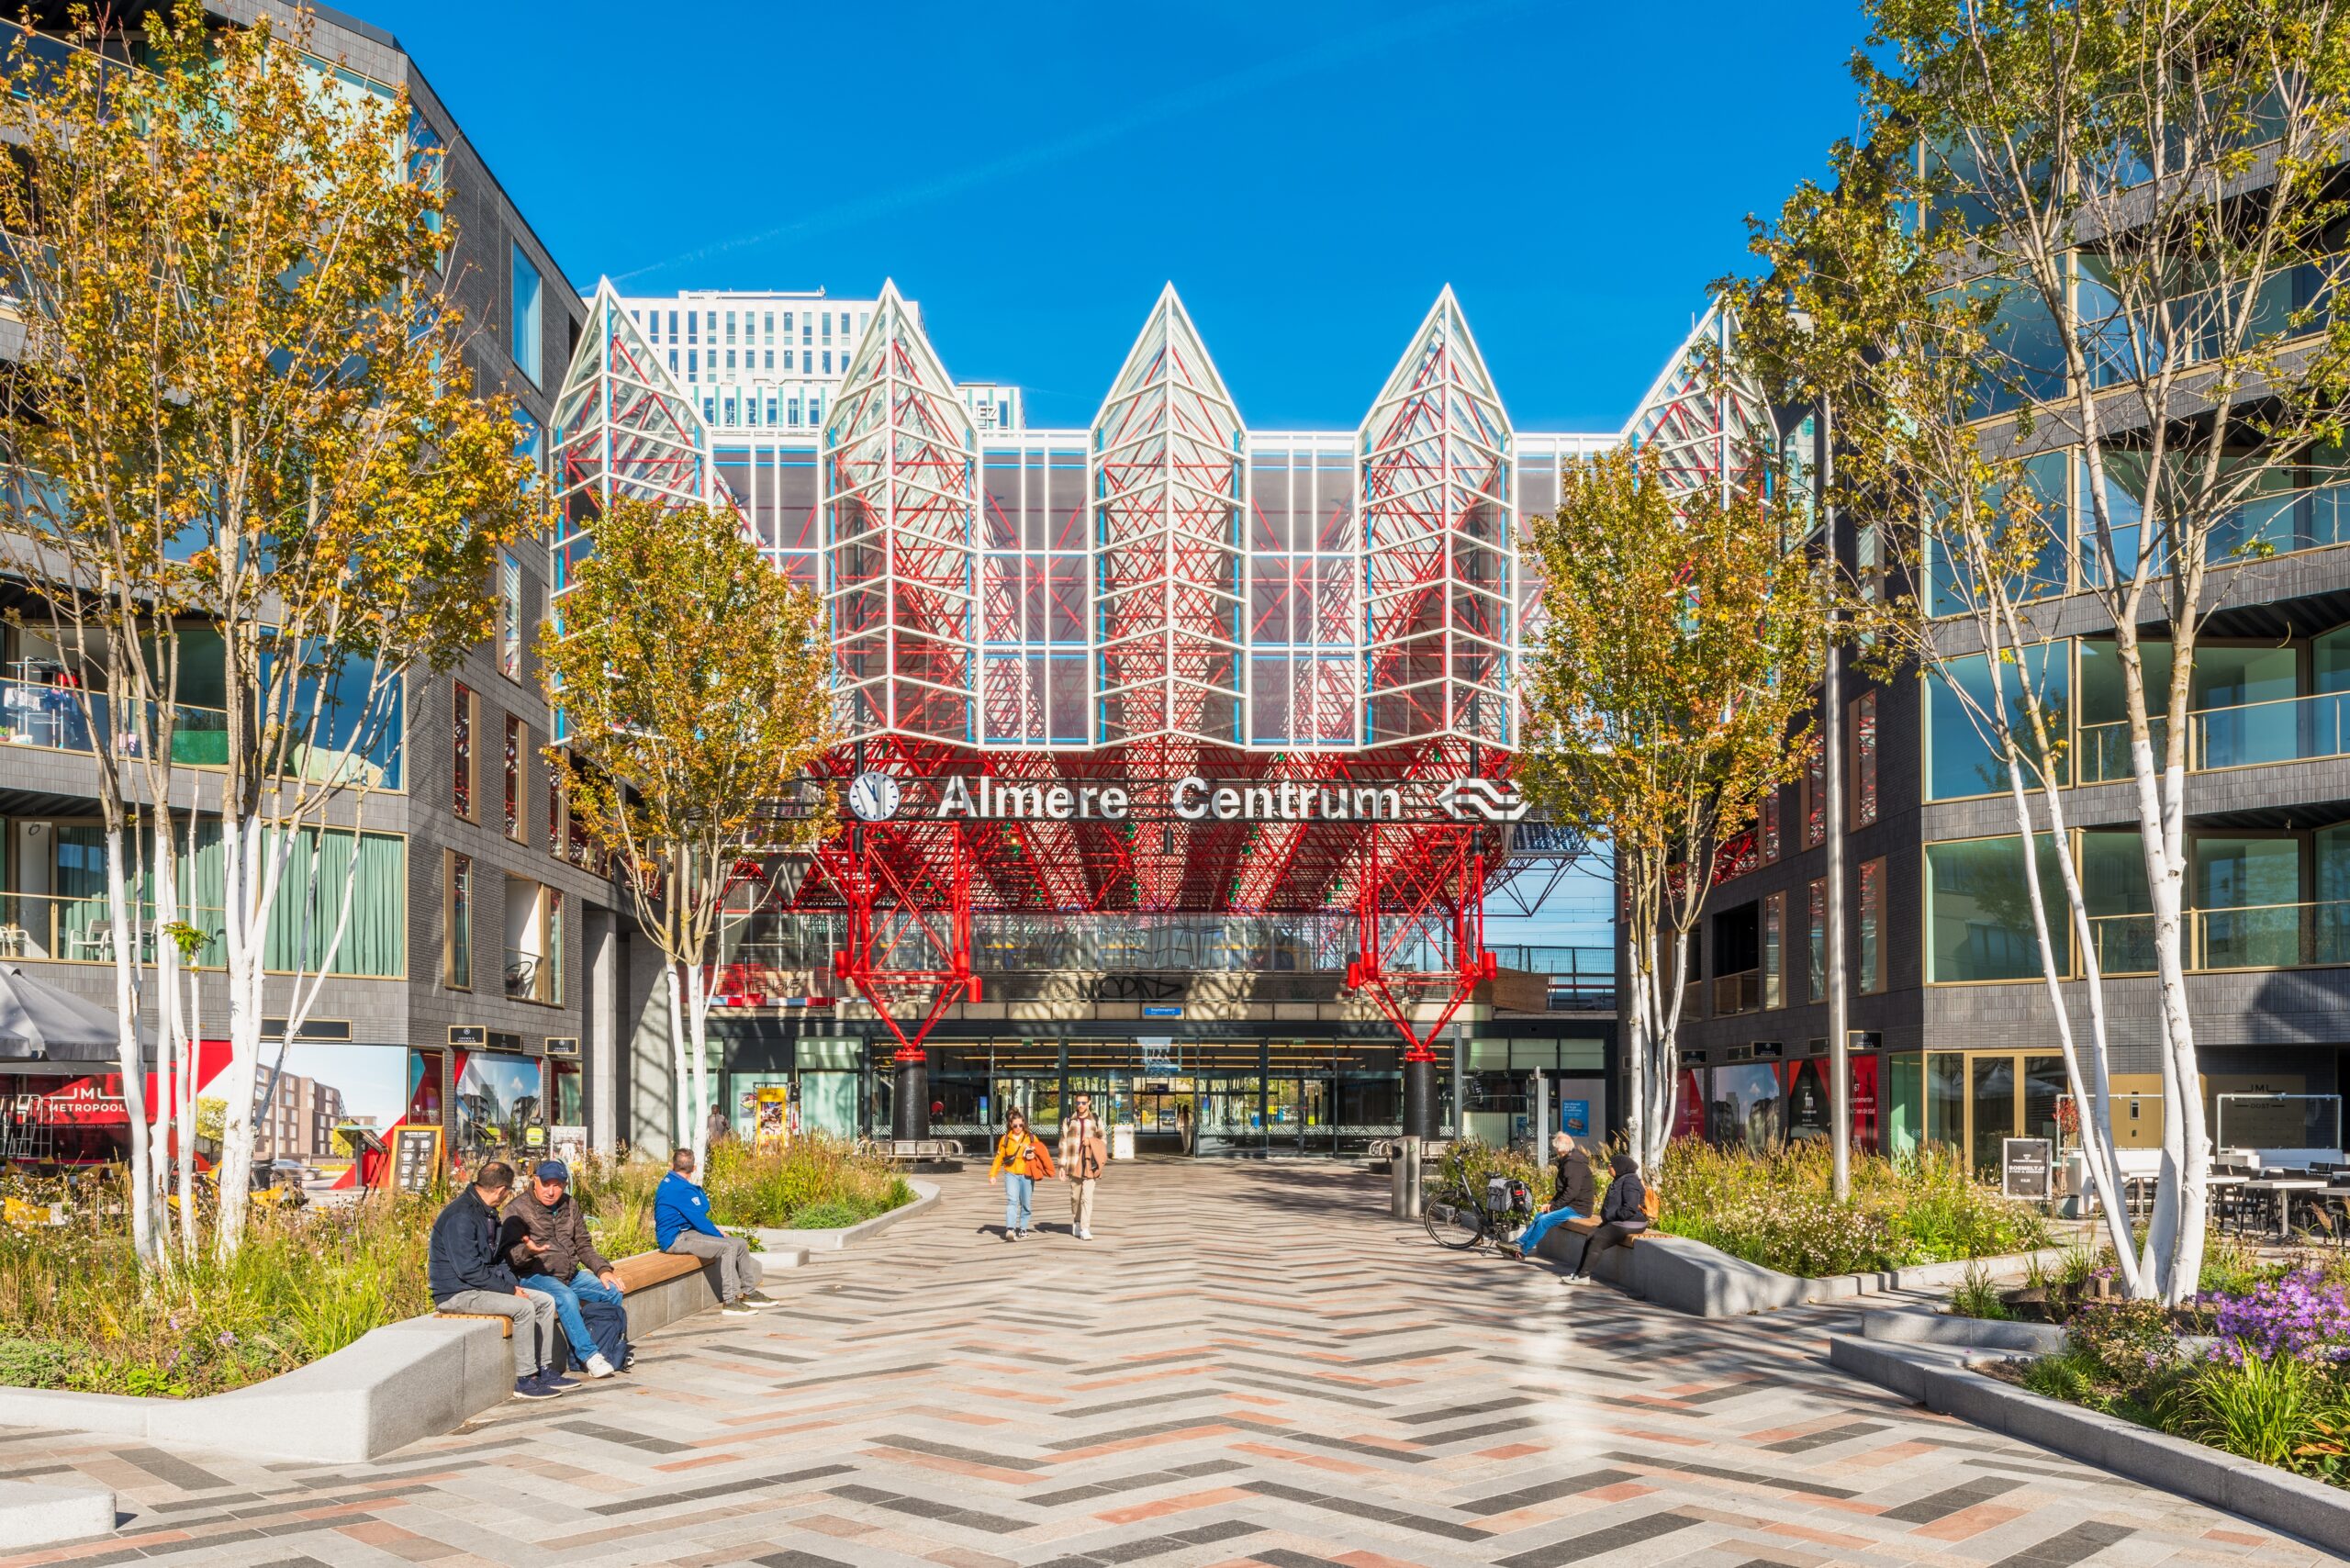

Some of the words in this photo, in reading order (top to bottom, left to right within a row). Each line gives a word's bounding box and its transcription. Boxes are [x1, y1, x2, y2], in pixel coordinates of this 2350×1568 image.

[936, 775, 1129, 820] Almere
[1172, 775, 1401, 820] Centrum
[1853, 1083, 1860, 1092] 67
[49, 1103, 126, 1113] METROPOOL
